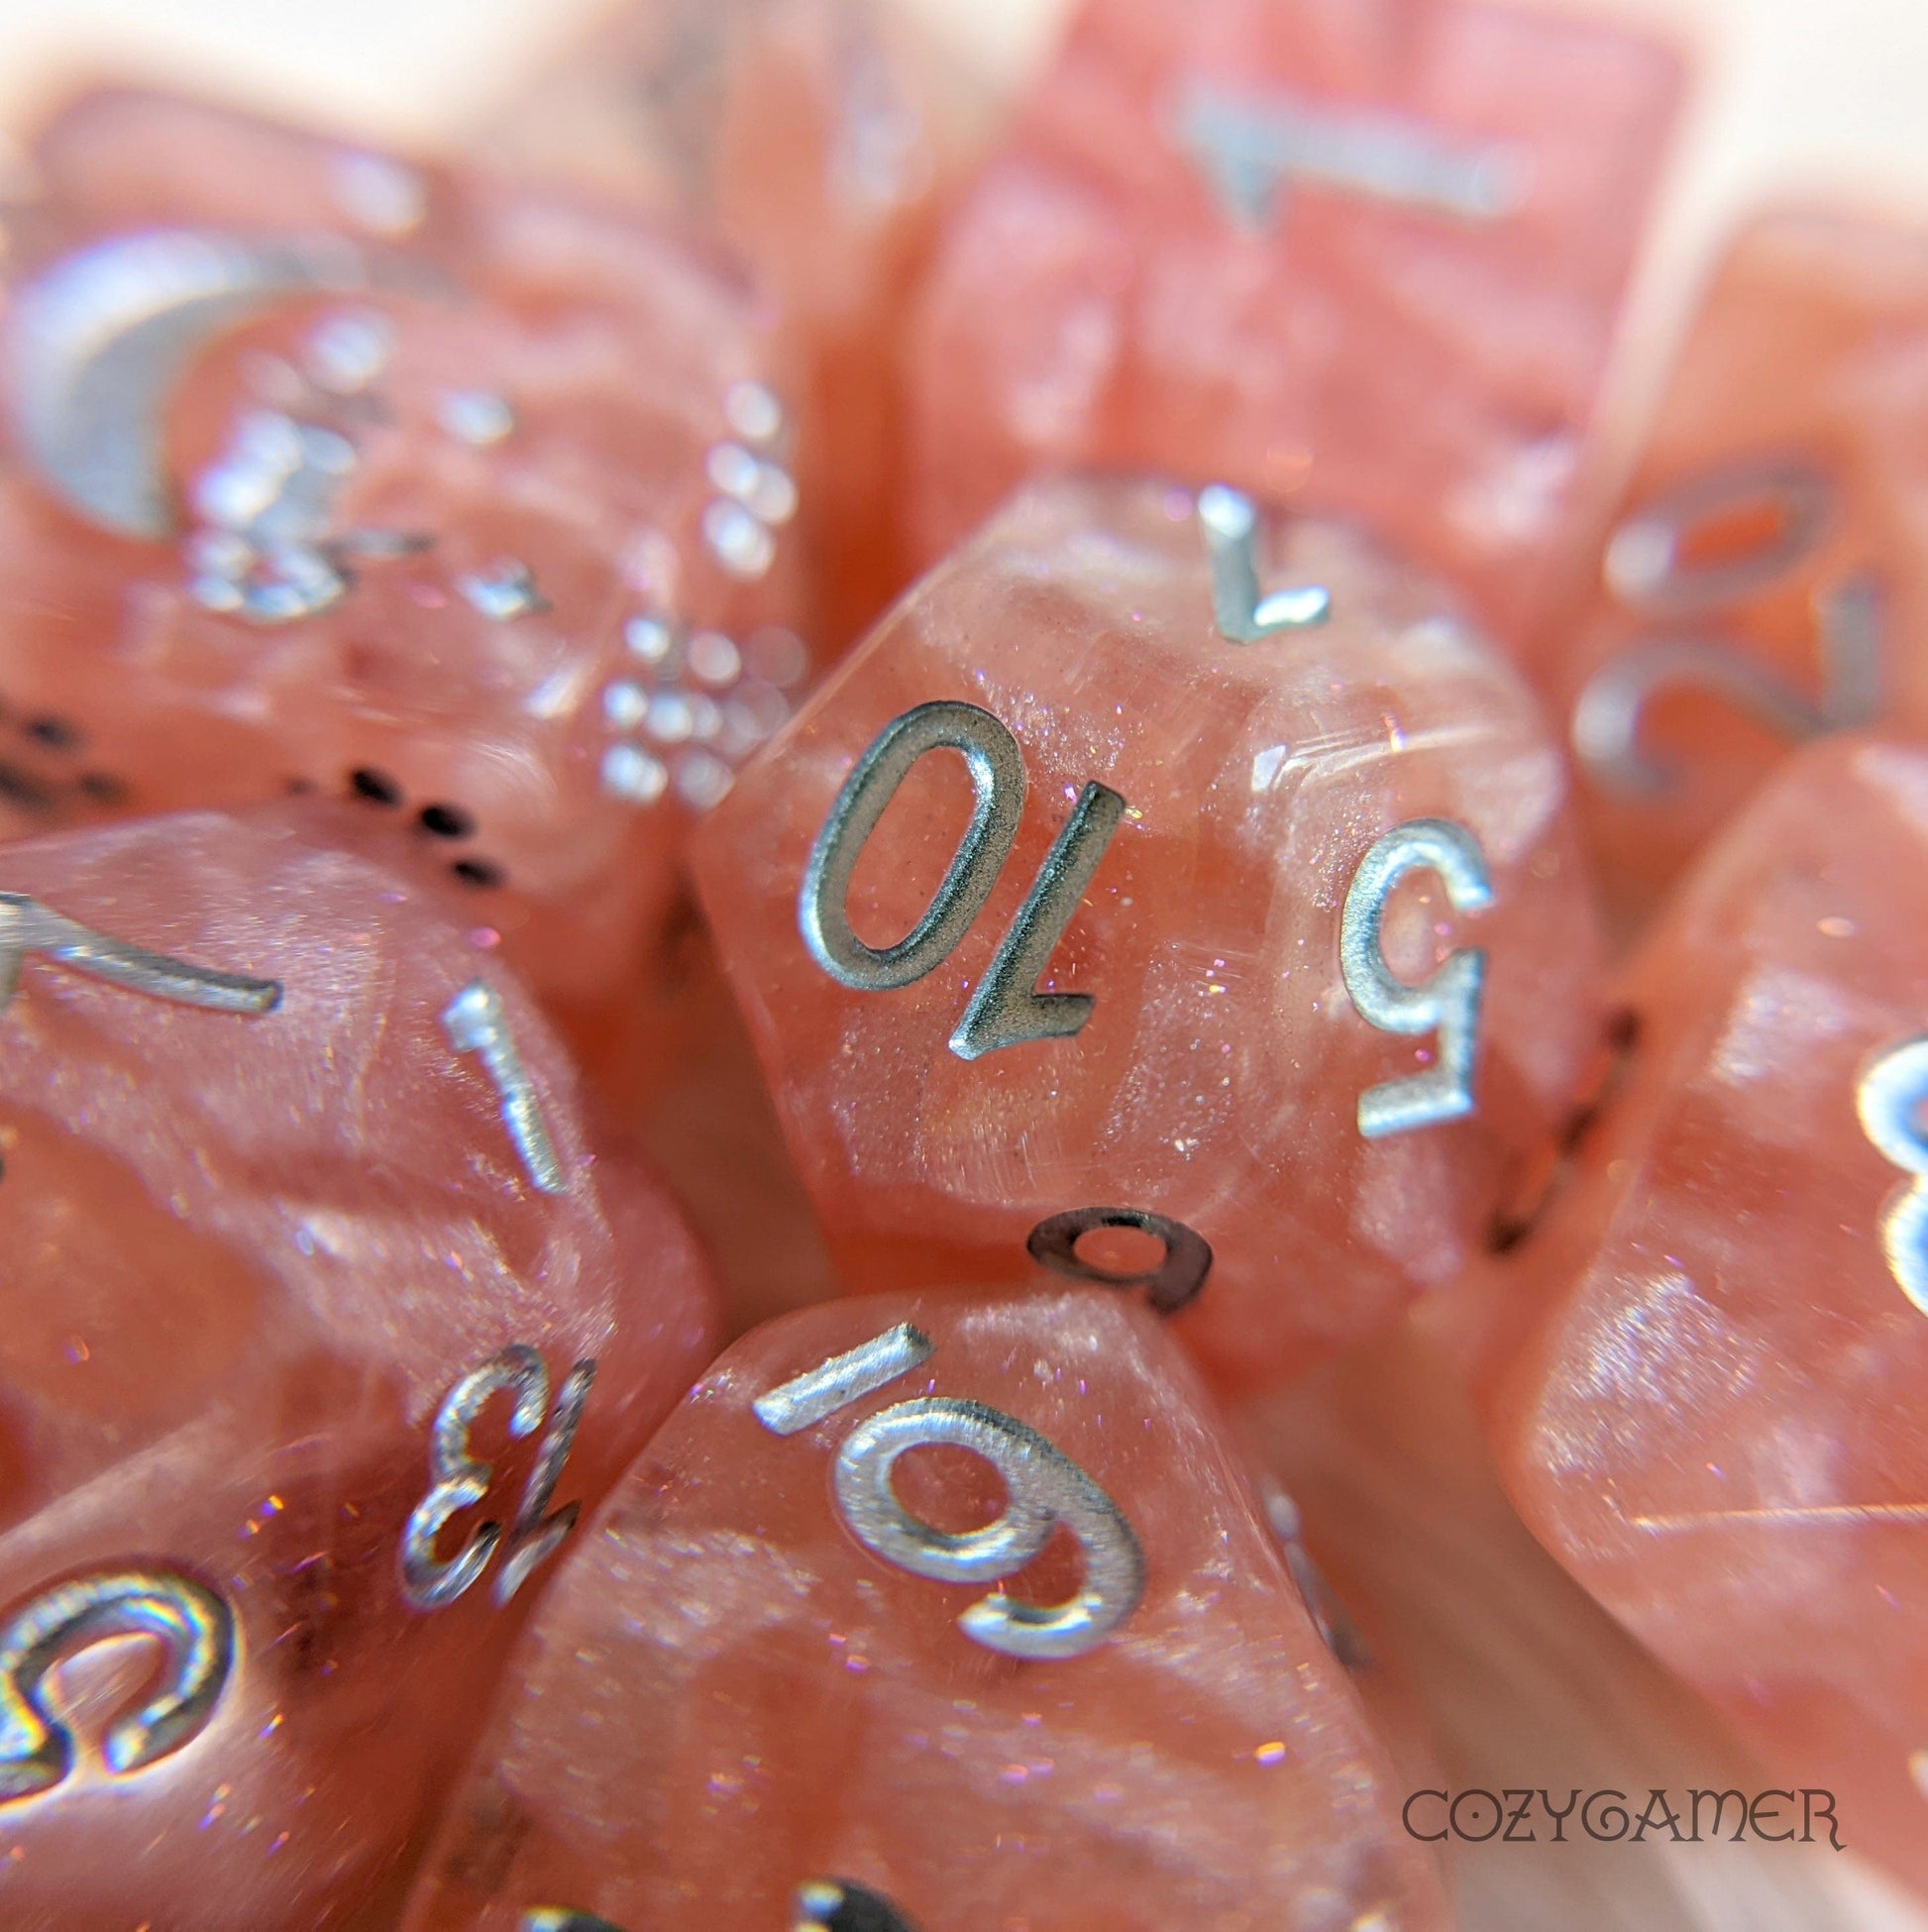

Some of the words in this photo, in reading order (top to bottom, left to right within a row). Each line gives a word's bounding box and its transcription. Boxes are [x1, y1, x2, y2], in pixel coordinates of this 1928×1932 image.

[800, 699, 1125, 1060] 10
[1340, 818, 1493, 1137] 5
[404, 1343, 597, 1607] 13
